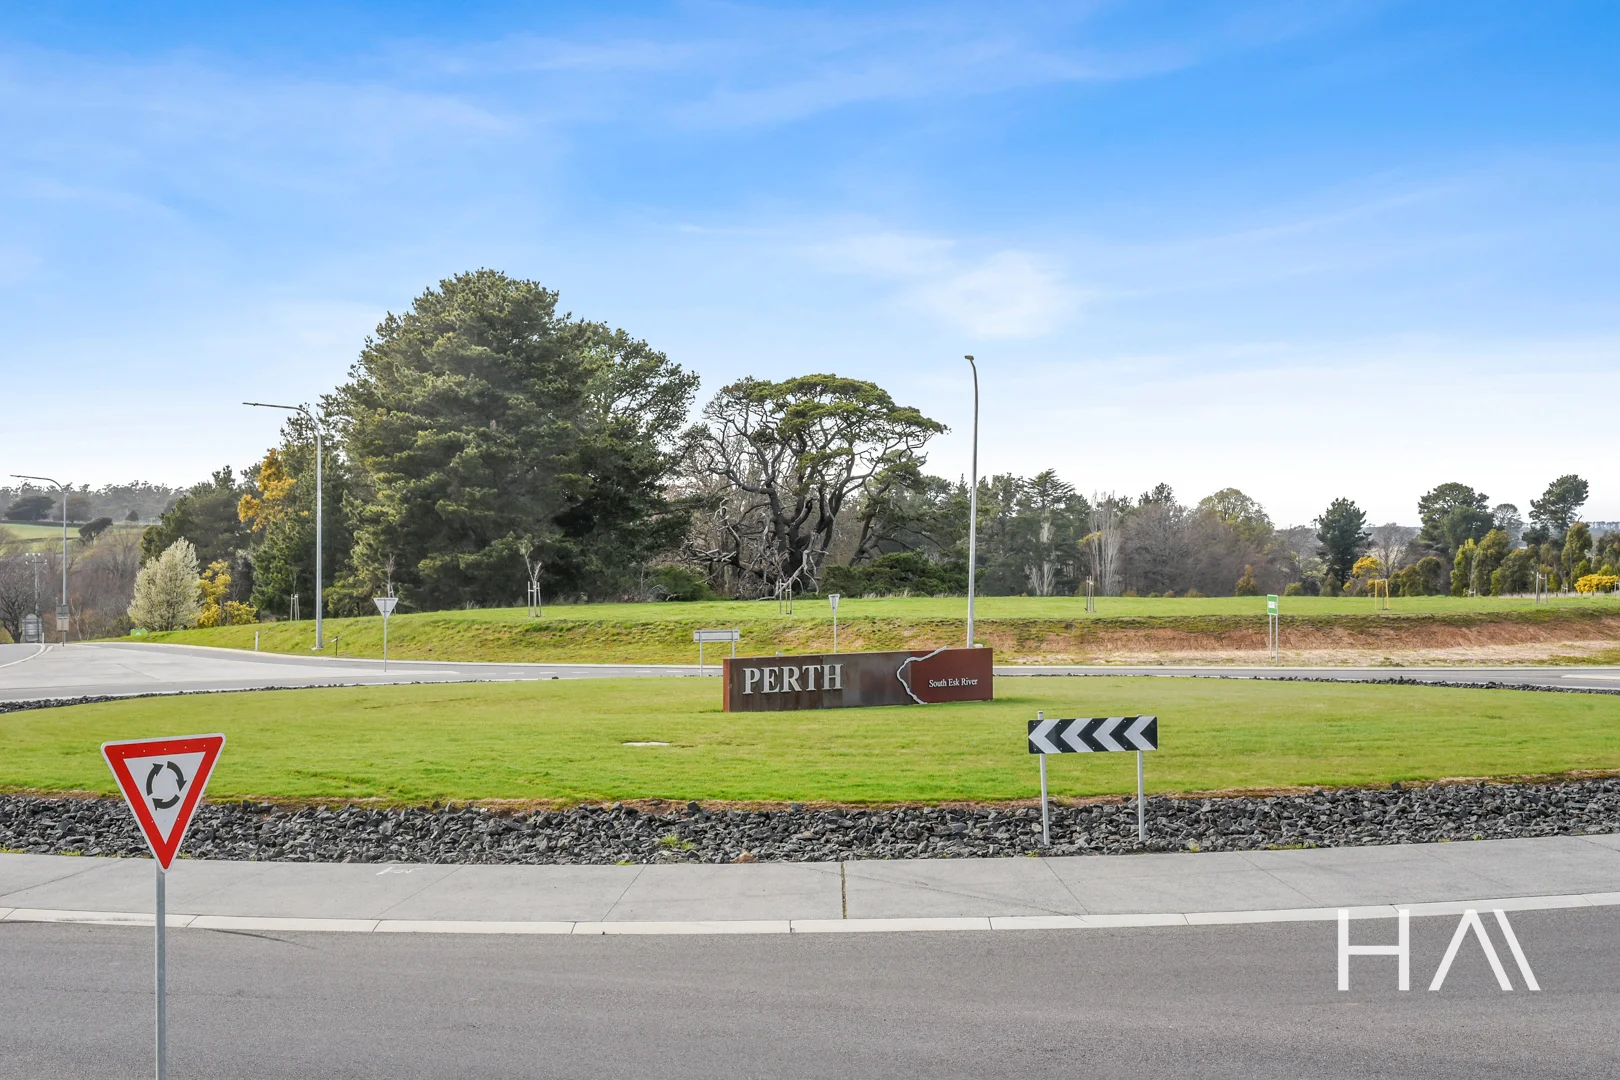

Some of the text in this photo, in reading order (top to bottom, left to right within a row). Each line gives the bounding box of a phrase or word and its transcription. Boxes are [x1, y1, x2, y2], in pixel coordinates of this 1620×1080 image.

[743, 664, 843, 695] PERTH
[929, 678, 978, 688] South Esk River
